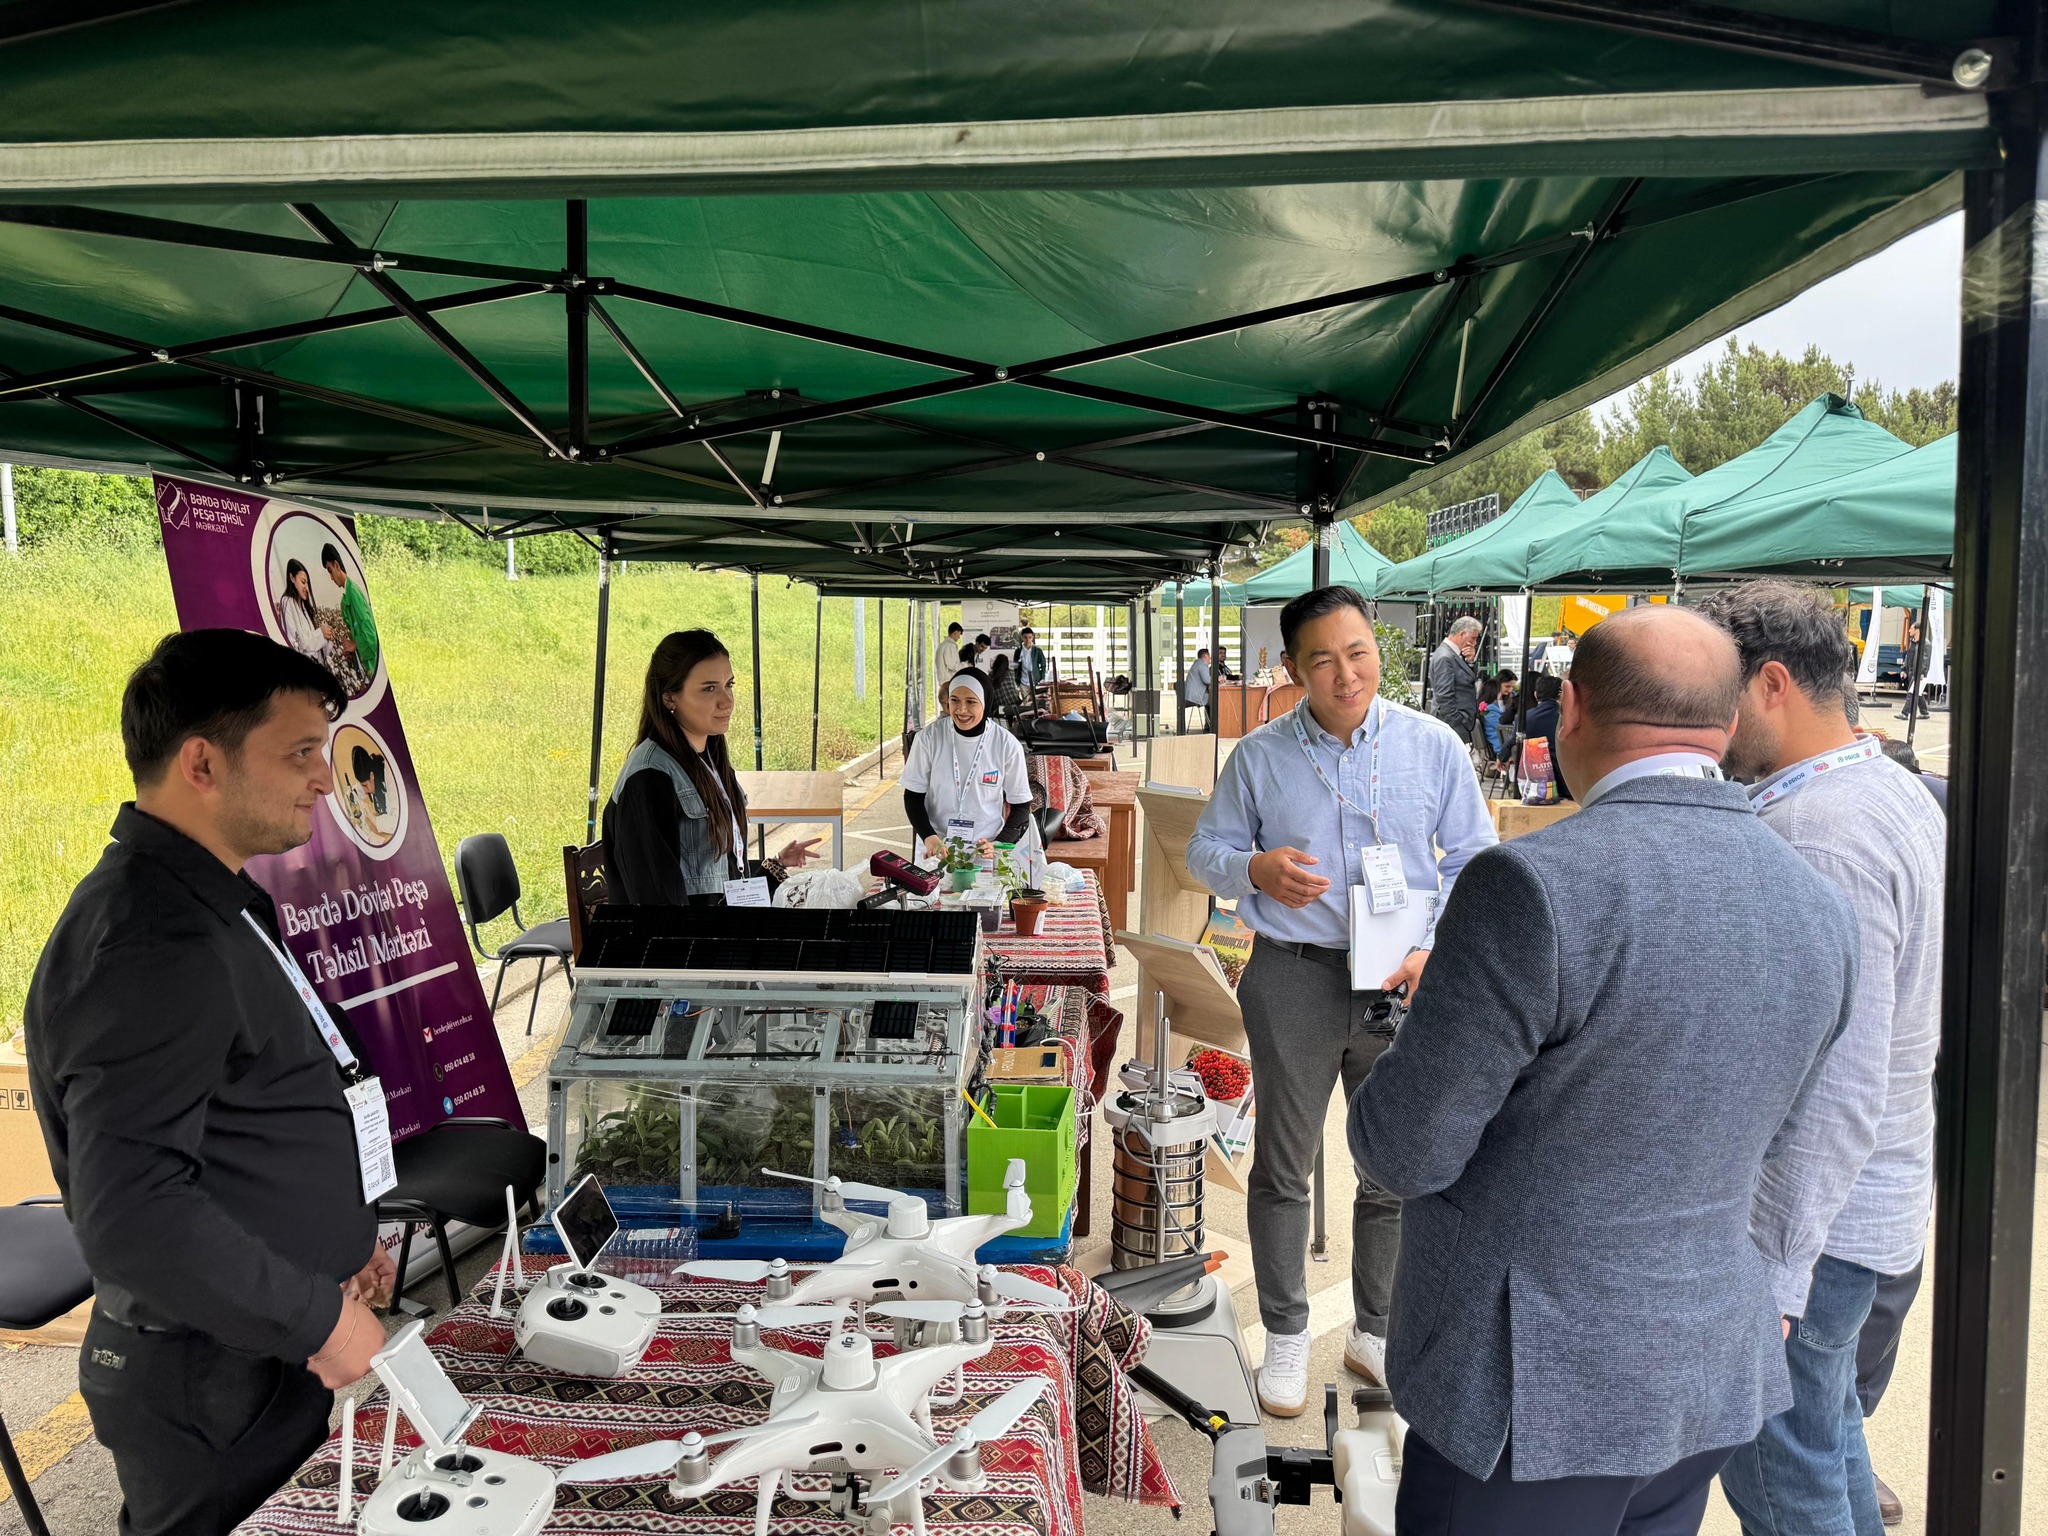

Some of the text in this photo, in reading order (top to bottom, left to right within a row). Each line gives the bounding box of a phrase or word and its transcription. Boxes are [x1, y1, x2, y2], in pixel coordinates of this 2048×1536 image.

[190, 493, 251, 515] BƏRDƏ DÖVLƏT
[192, 508, 215, 522] PEŞƏ
[195, 521, 229, 534] MƏRKƏZİ
[1844, 753, 1860, 762] PRIOR
[1788, 772, 1806, 785] PRIOR
[280, 877, 429, 937] Bərdə Dövlət Peşə
[306, 917, 433, 984] Təhsil Mərkəzi
